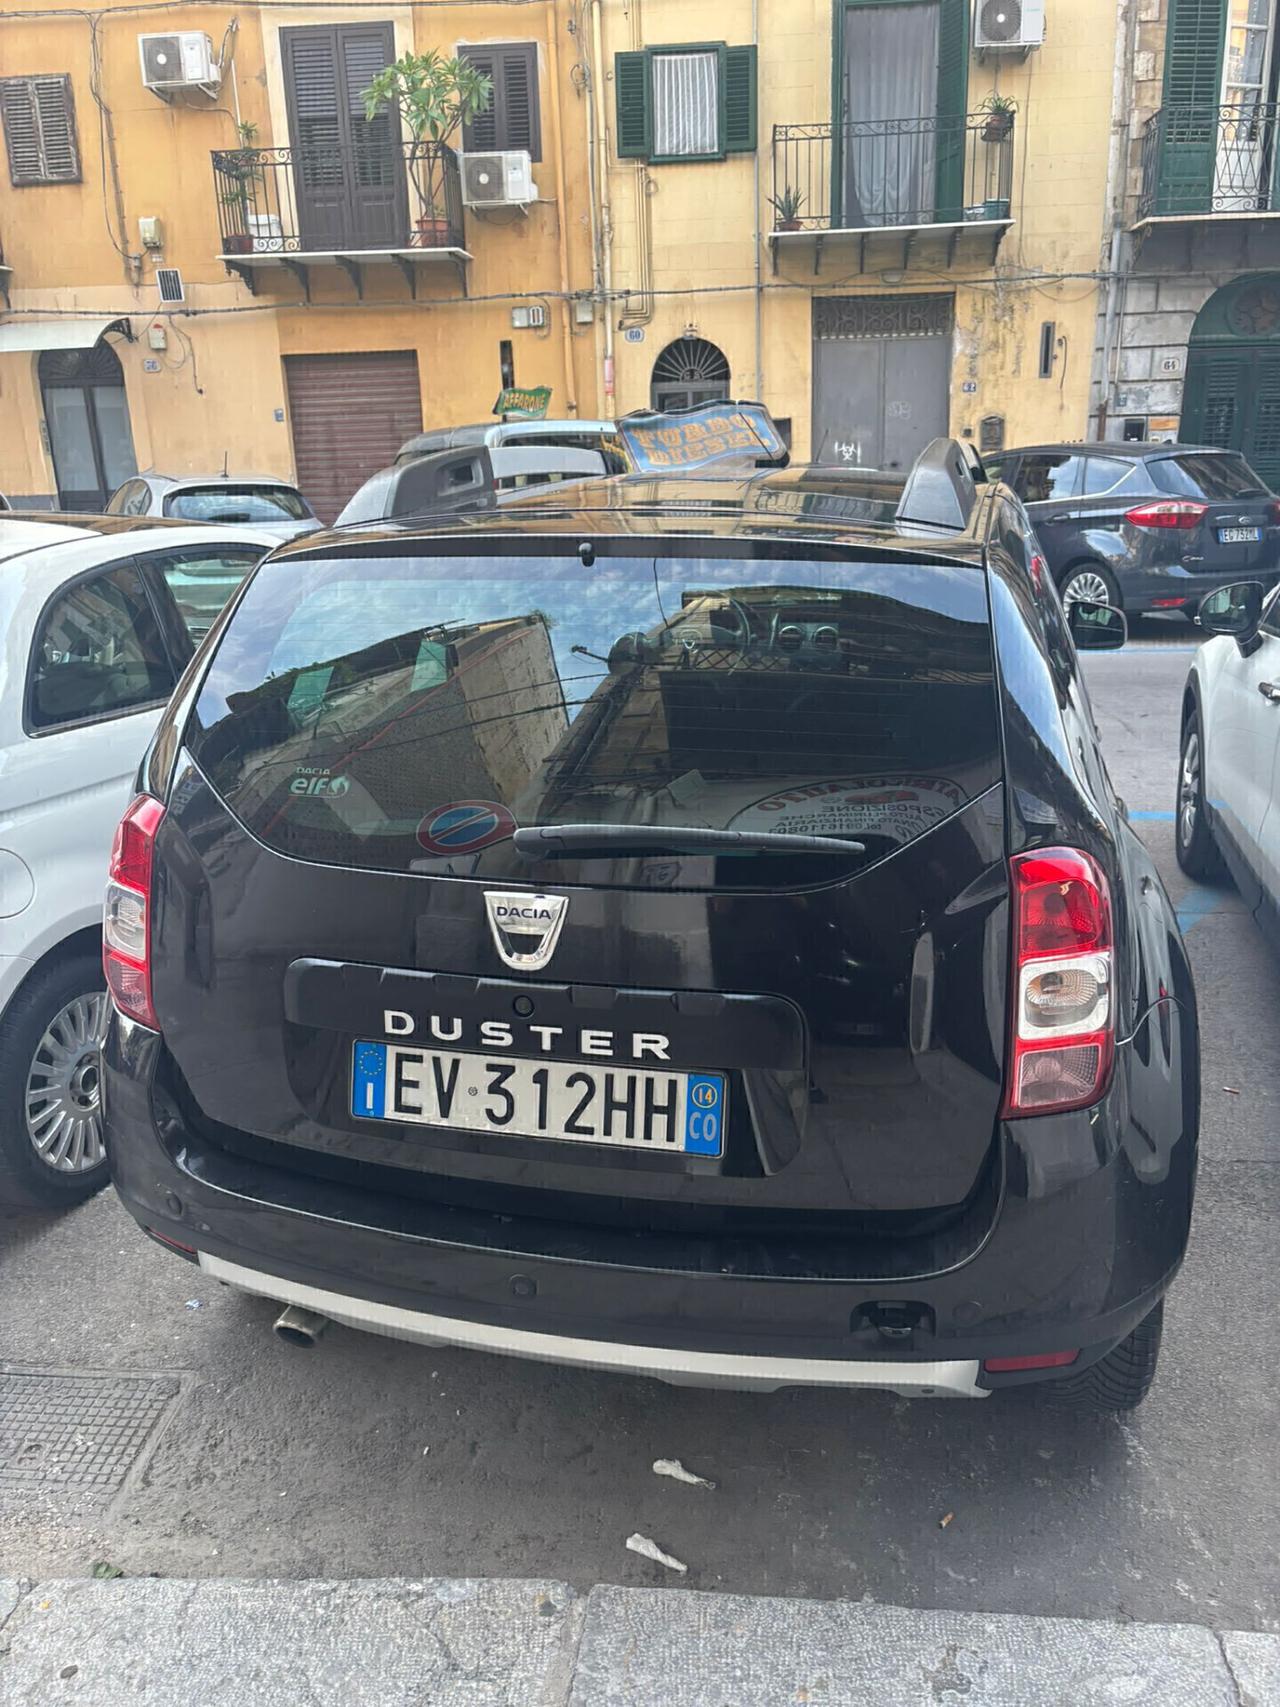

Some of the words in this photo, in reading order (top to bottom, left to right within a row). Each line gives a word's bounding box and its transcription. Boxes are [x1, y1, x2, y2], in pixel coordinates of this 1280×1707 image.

[628, 330, 641, 339] 60
[630, 413, 757, 449] TURBO
[645, 430, 772, 466] DIESEL
[296, 766, 331, 775] DACIA
[290, 776, 330, 795] elf
[496, 906, 552, 920] DACIA
[383, 1009, 672, 1060] DUSTER
[365, 1081, 374, 1110] I
[697, 1087, 713, 1104] 14
[688, 1112, 719, 1143] CO
